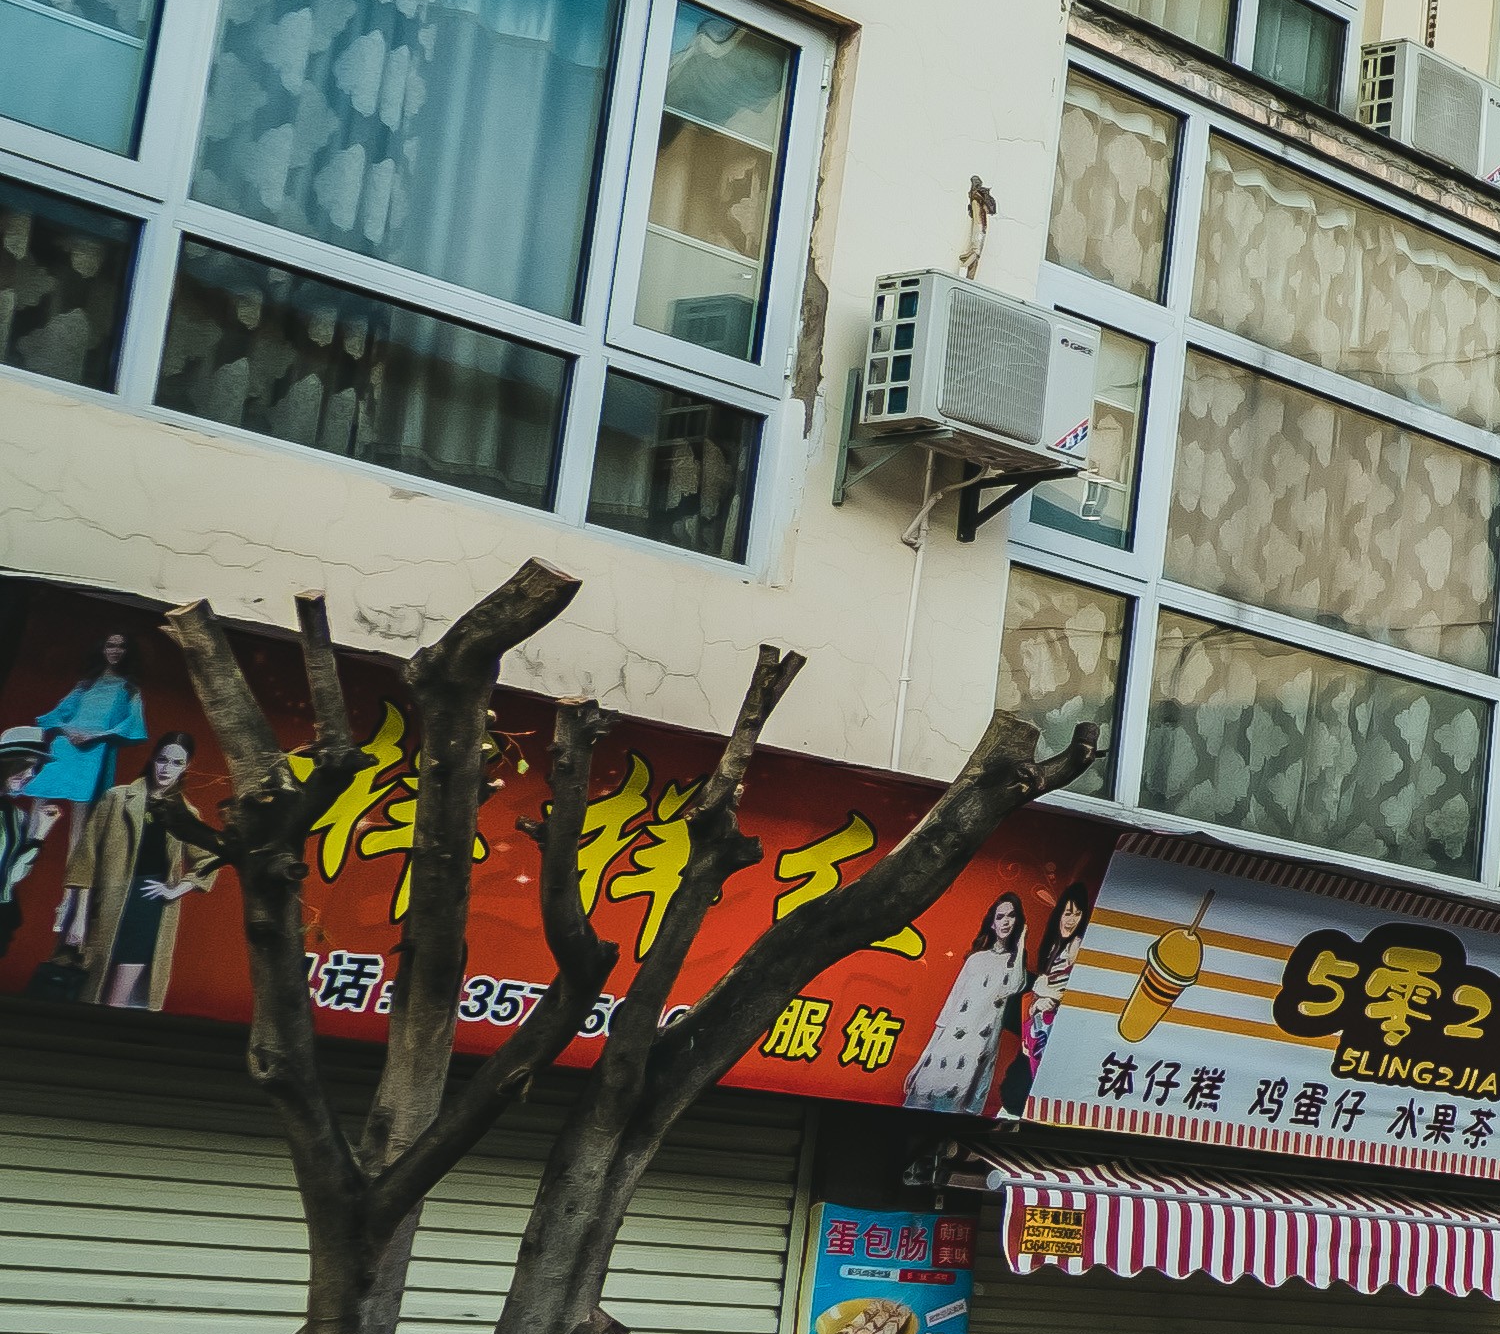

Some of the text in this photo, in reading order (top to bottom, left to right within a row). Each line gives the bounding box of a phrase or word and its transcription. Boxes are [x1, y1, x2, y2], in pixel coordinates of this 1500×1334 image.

[764, 995, 902, 1070] 服饰
[1097, 1051, 1226, 1113] 钵仔糕
[1246, 1078, 1367, 1135] 鸡蛋仔
[1386, 1097, 1497, 1149] 水果茶
[1339, 1047, 1499, 1095] 5LING2JIA
[826, 1219, 929, 1262] 蛋包肠
